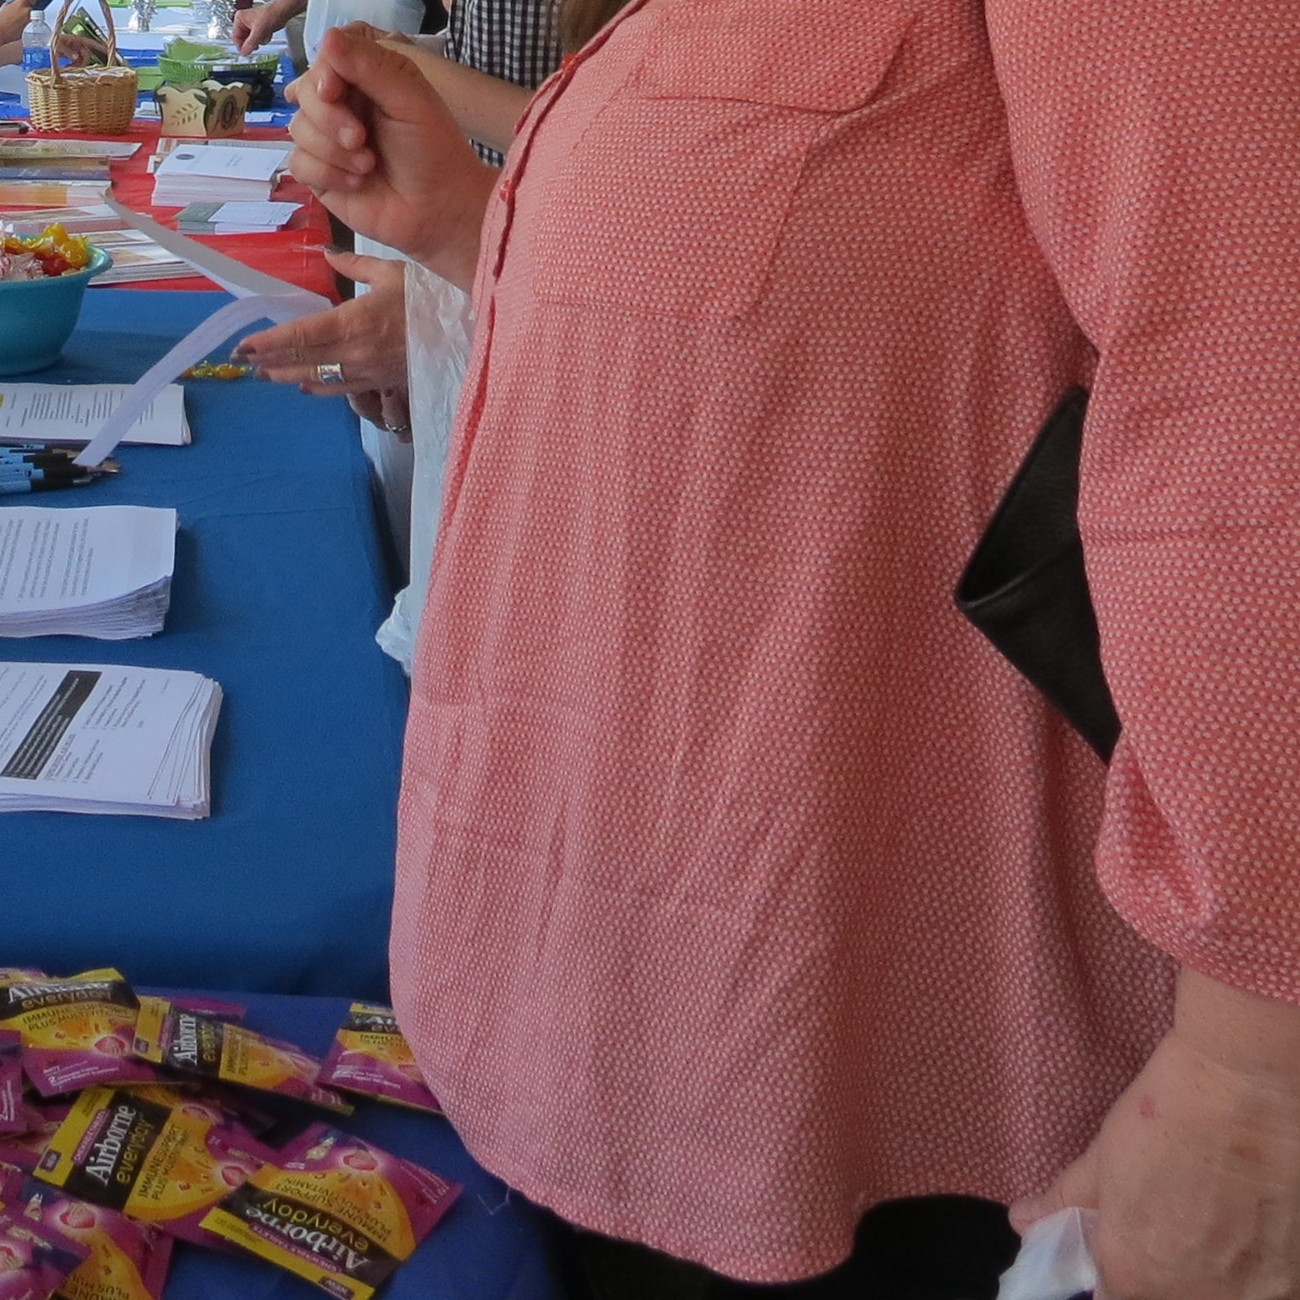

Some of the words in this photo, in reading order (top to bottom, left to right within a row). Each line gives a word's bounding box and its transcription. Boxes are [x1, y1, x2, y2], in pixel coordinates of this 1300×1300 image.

[85, 1105, 136, 1187] Airborne
[113, 1117, 153, 1185] everyday
[246, 1203, 372, 1270] Airborne
[263, 1198, 370, 1251] everyday
